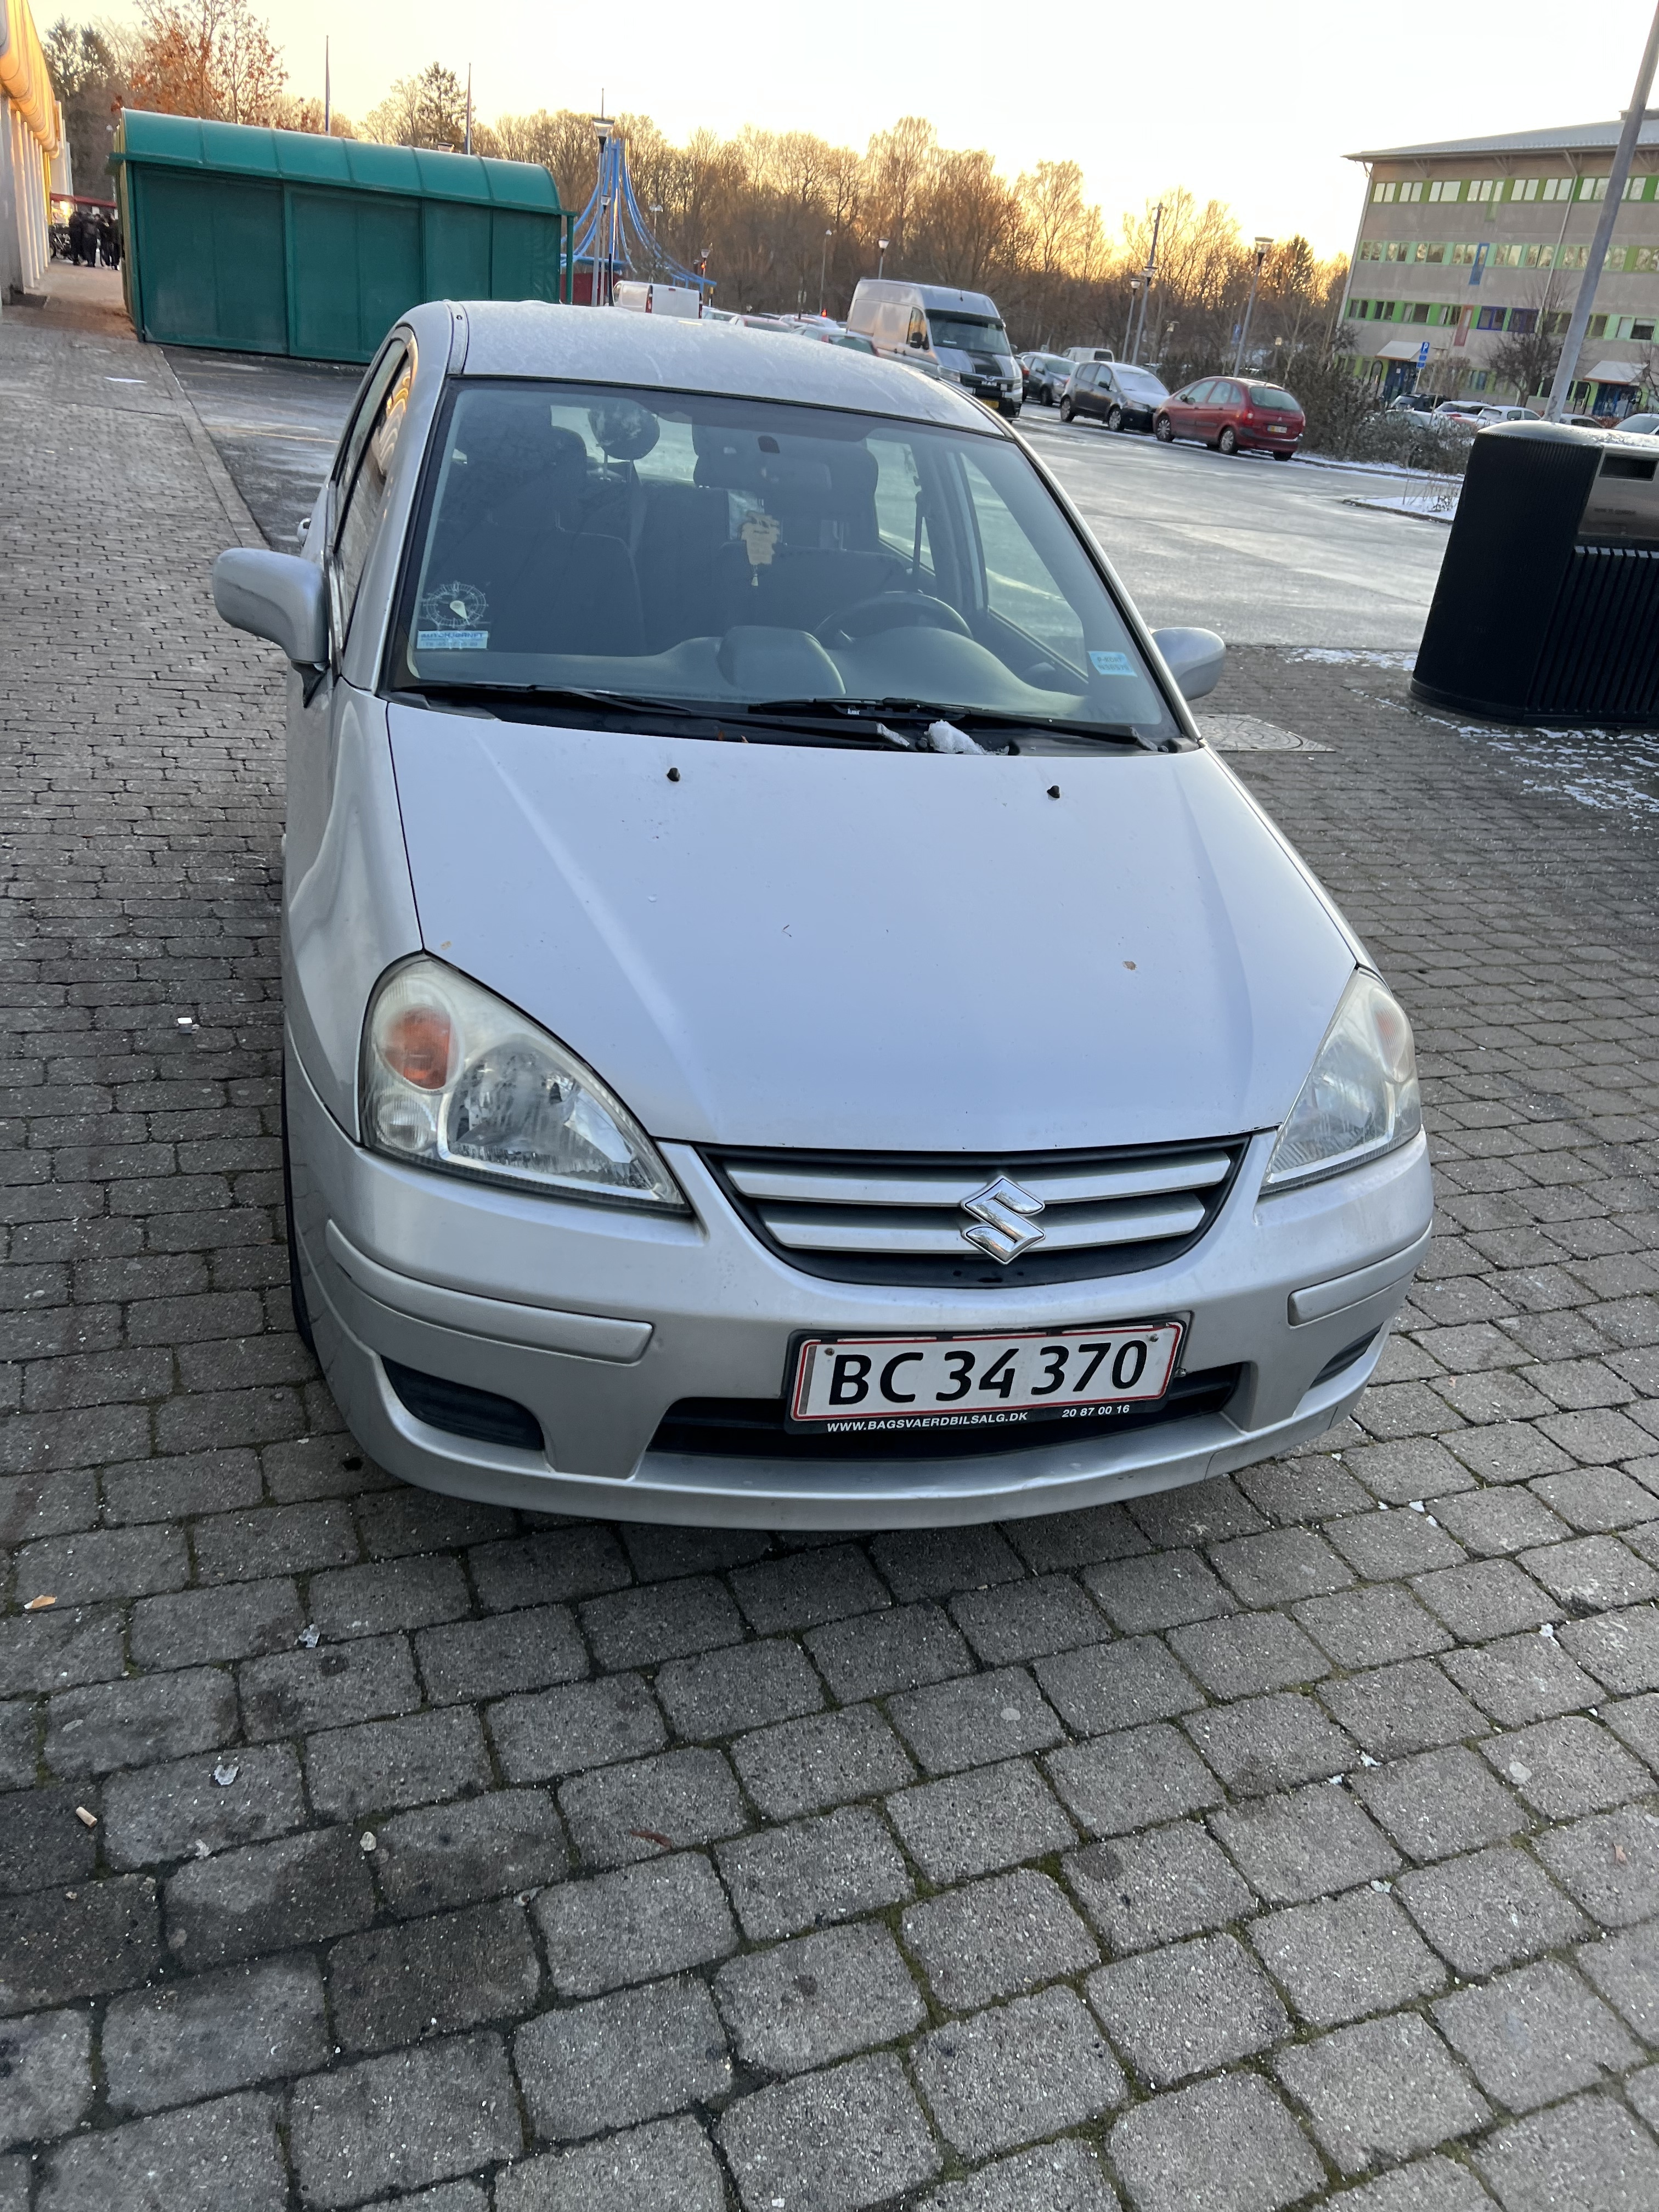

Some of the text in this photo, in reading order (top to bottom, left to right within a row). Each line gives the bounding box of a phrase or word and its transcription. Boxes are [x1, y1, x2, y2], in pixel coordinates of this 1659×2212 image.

[828, 1340, 1147, 1405] BC 34 370
[1062, 1404, 1130, 1418] 20 87 00 16
[827, 1412, 1027, 1432] WWW.BAGSVAERDBILSALG.DK
